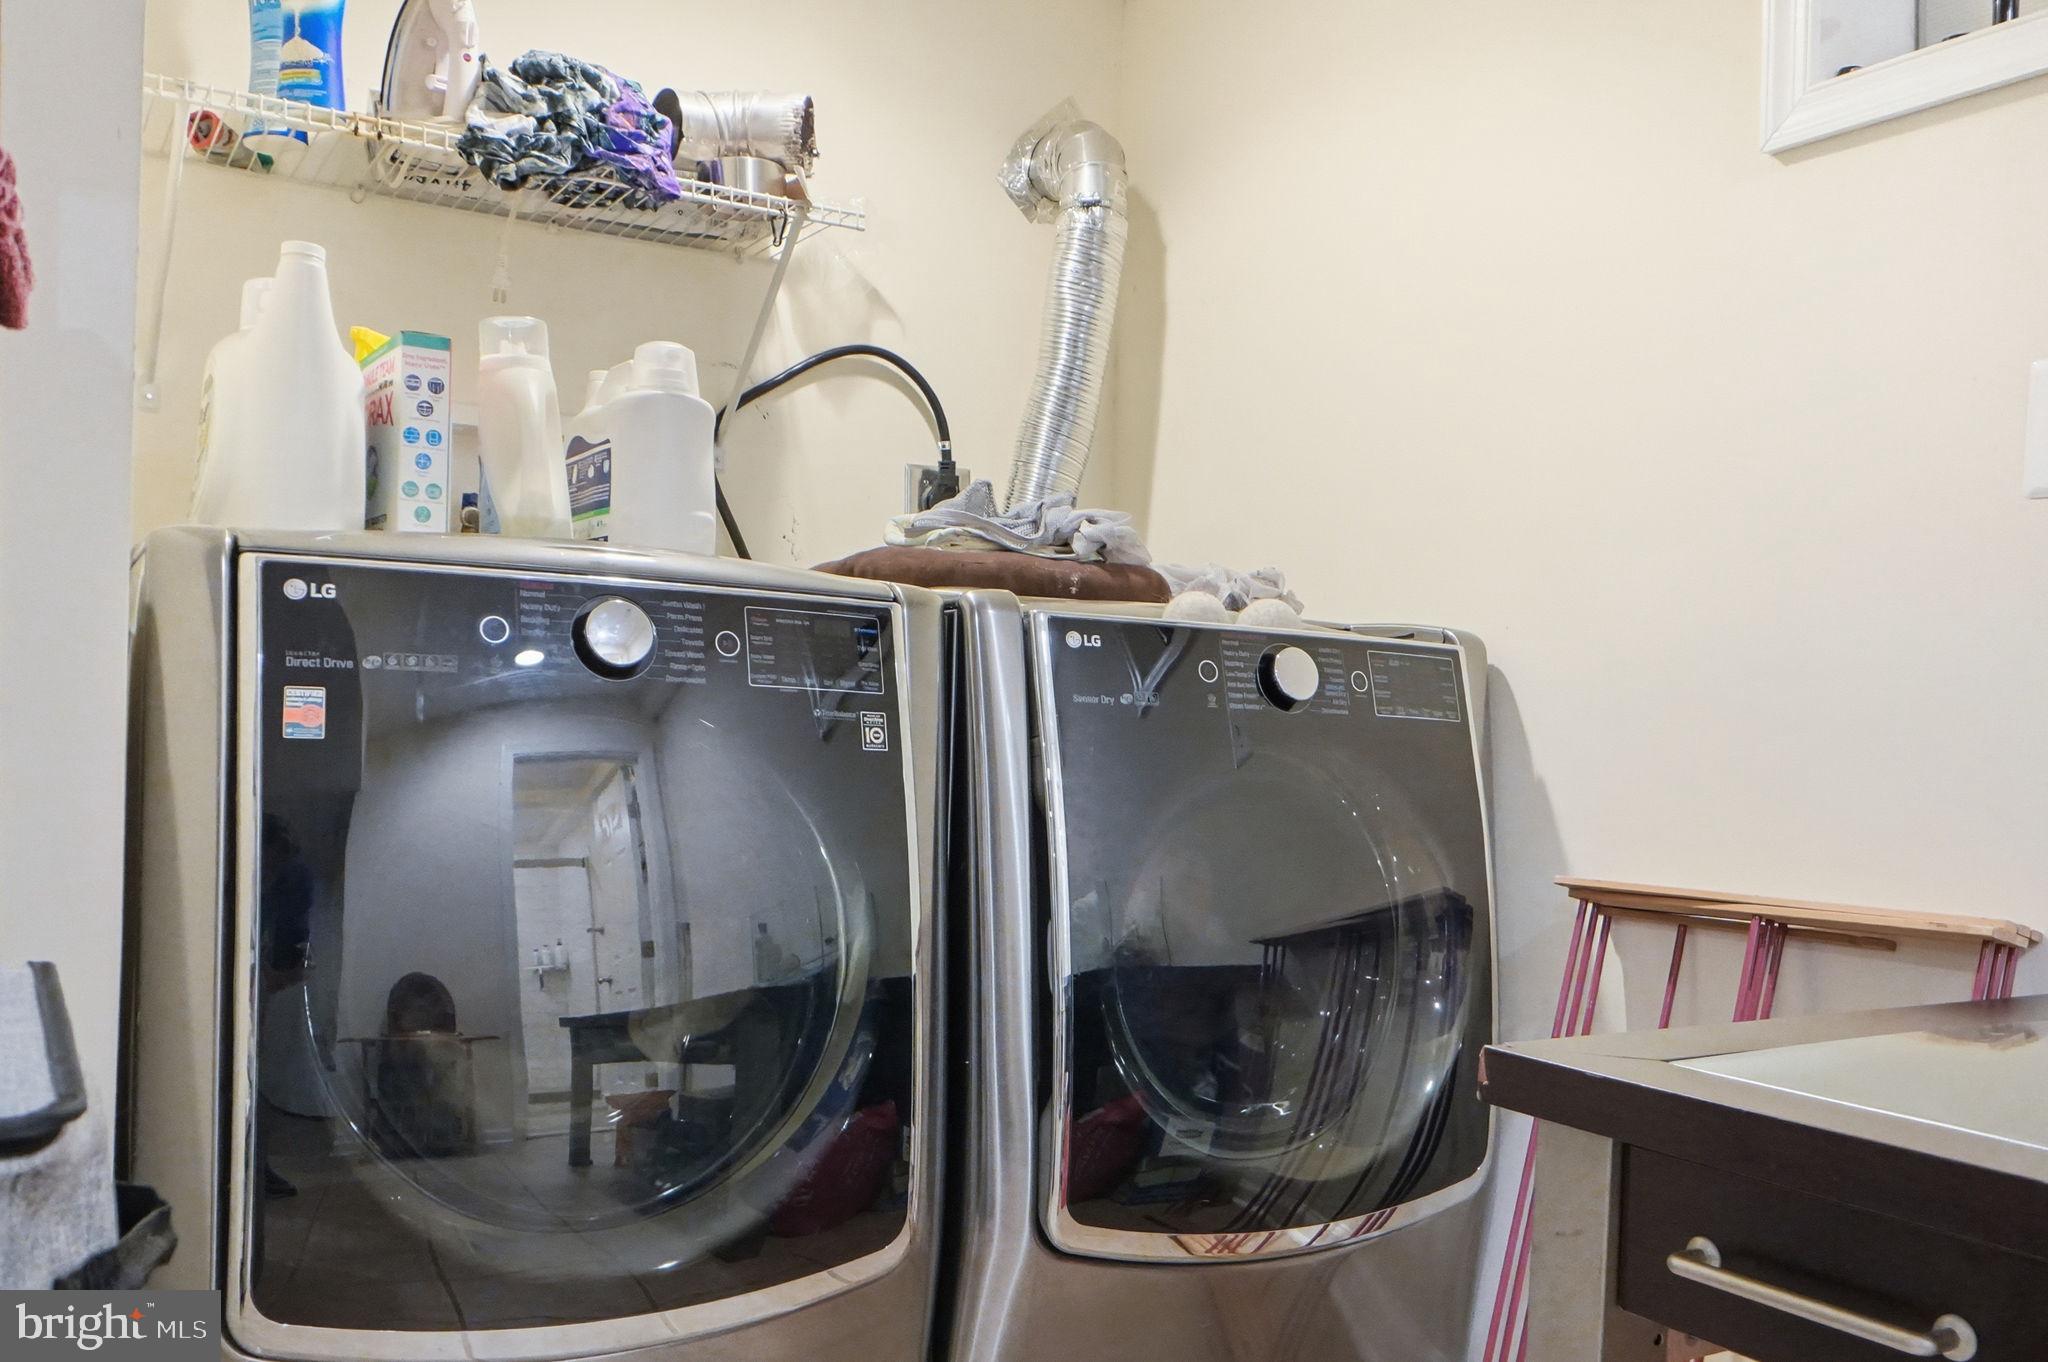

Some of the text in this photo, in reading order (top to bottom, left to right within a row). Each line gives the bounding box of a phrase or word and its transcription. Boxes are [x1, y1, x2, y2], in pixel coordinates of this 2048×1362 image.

[366, 390, 394, 427] RAX
[309, 582, 337, 599] LG
[543, 603, 561, 614] Duty
[1083, 633, 1102, 647] LG
[285, 656, 321, 668] Direct
[323, 656, 354, 669] Drive
[1072, 693, 1115, 706] Sensor Dry
[865, 727, 884, 744] 10
